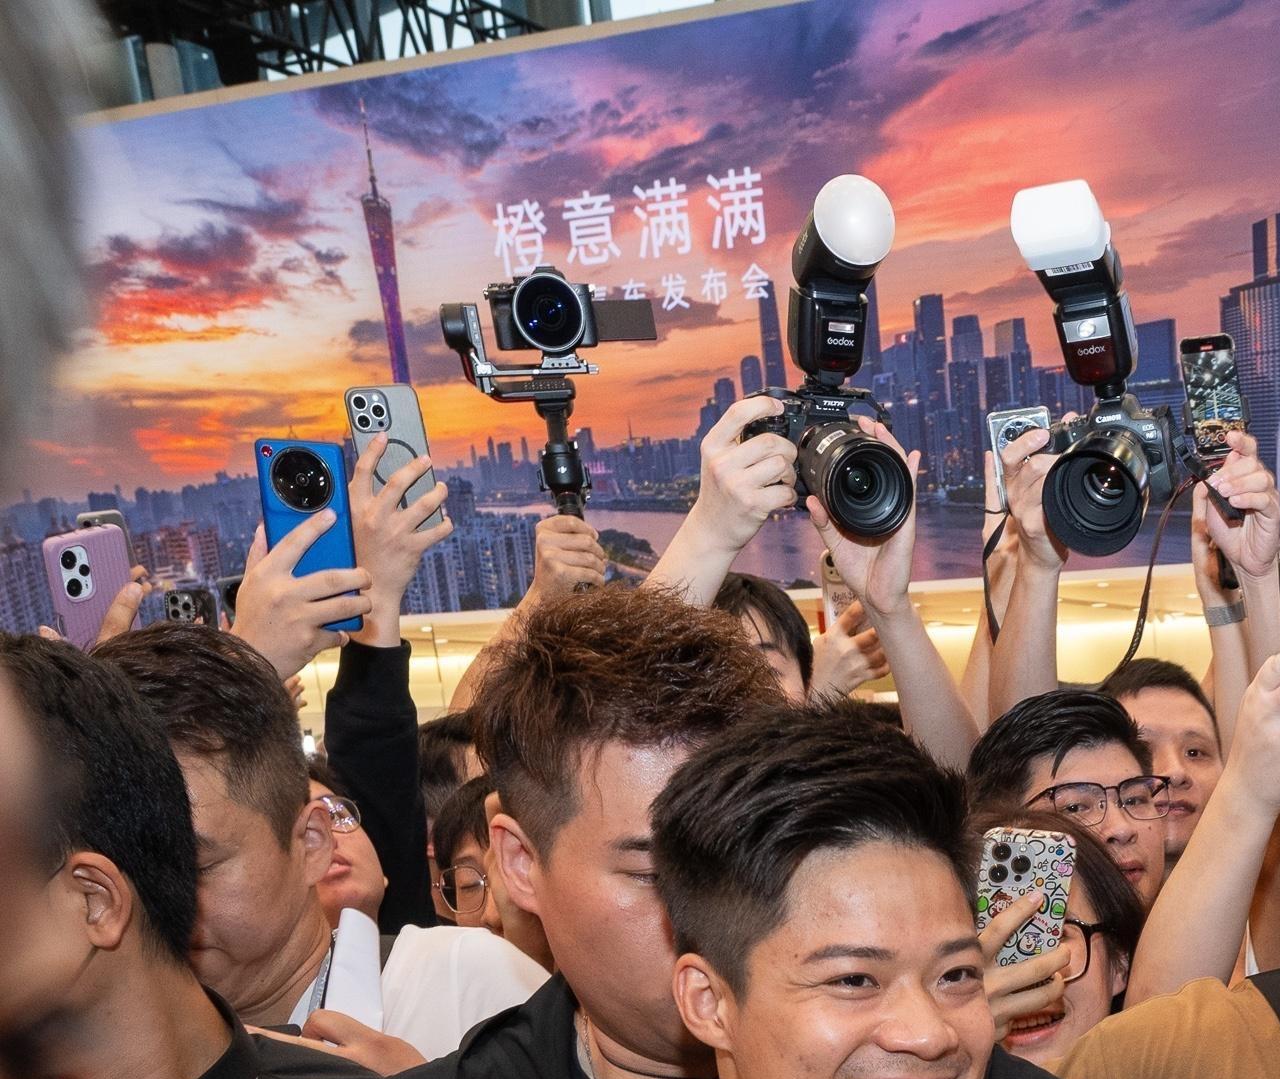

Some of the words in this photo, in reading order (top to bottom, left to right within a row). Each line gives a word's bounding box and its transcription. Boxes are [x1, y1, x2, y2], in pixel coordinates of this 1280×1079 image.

[492, 166, 768, 278] 橙意满满
[827, 336, 855, 347] Godox
[1077, 345, 1106, 356] Godox
[1095, 414, 1121, 424] Canon
